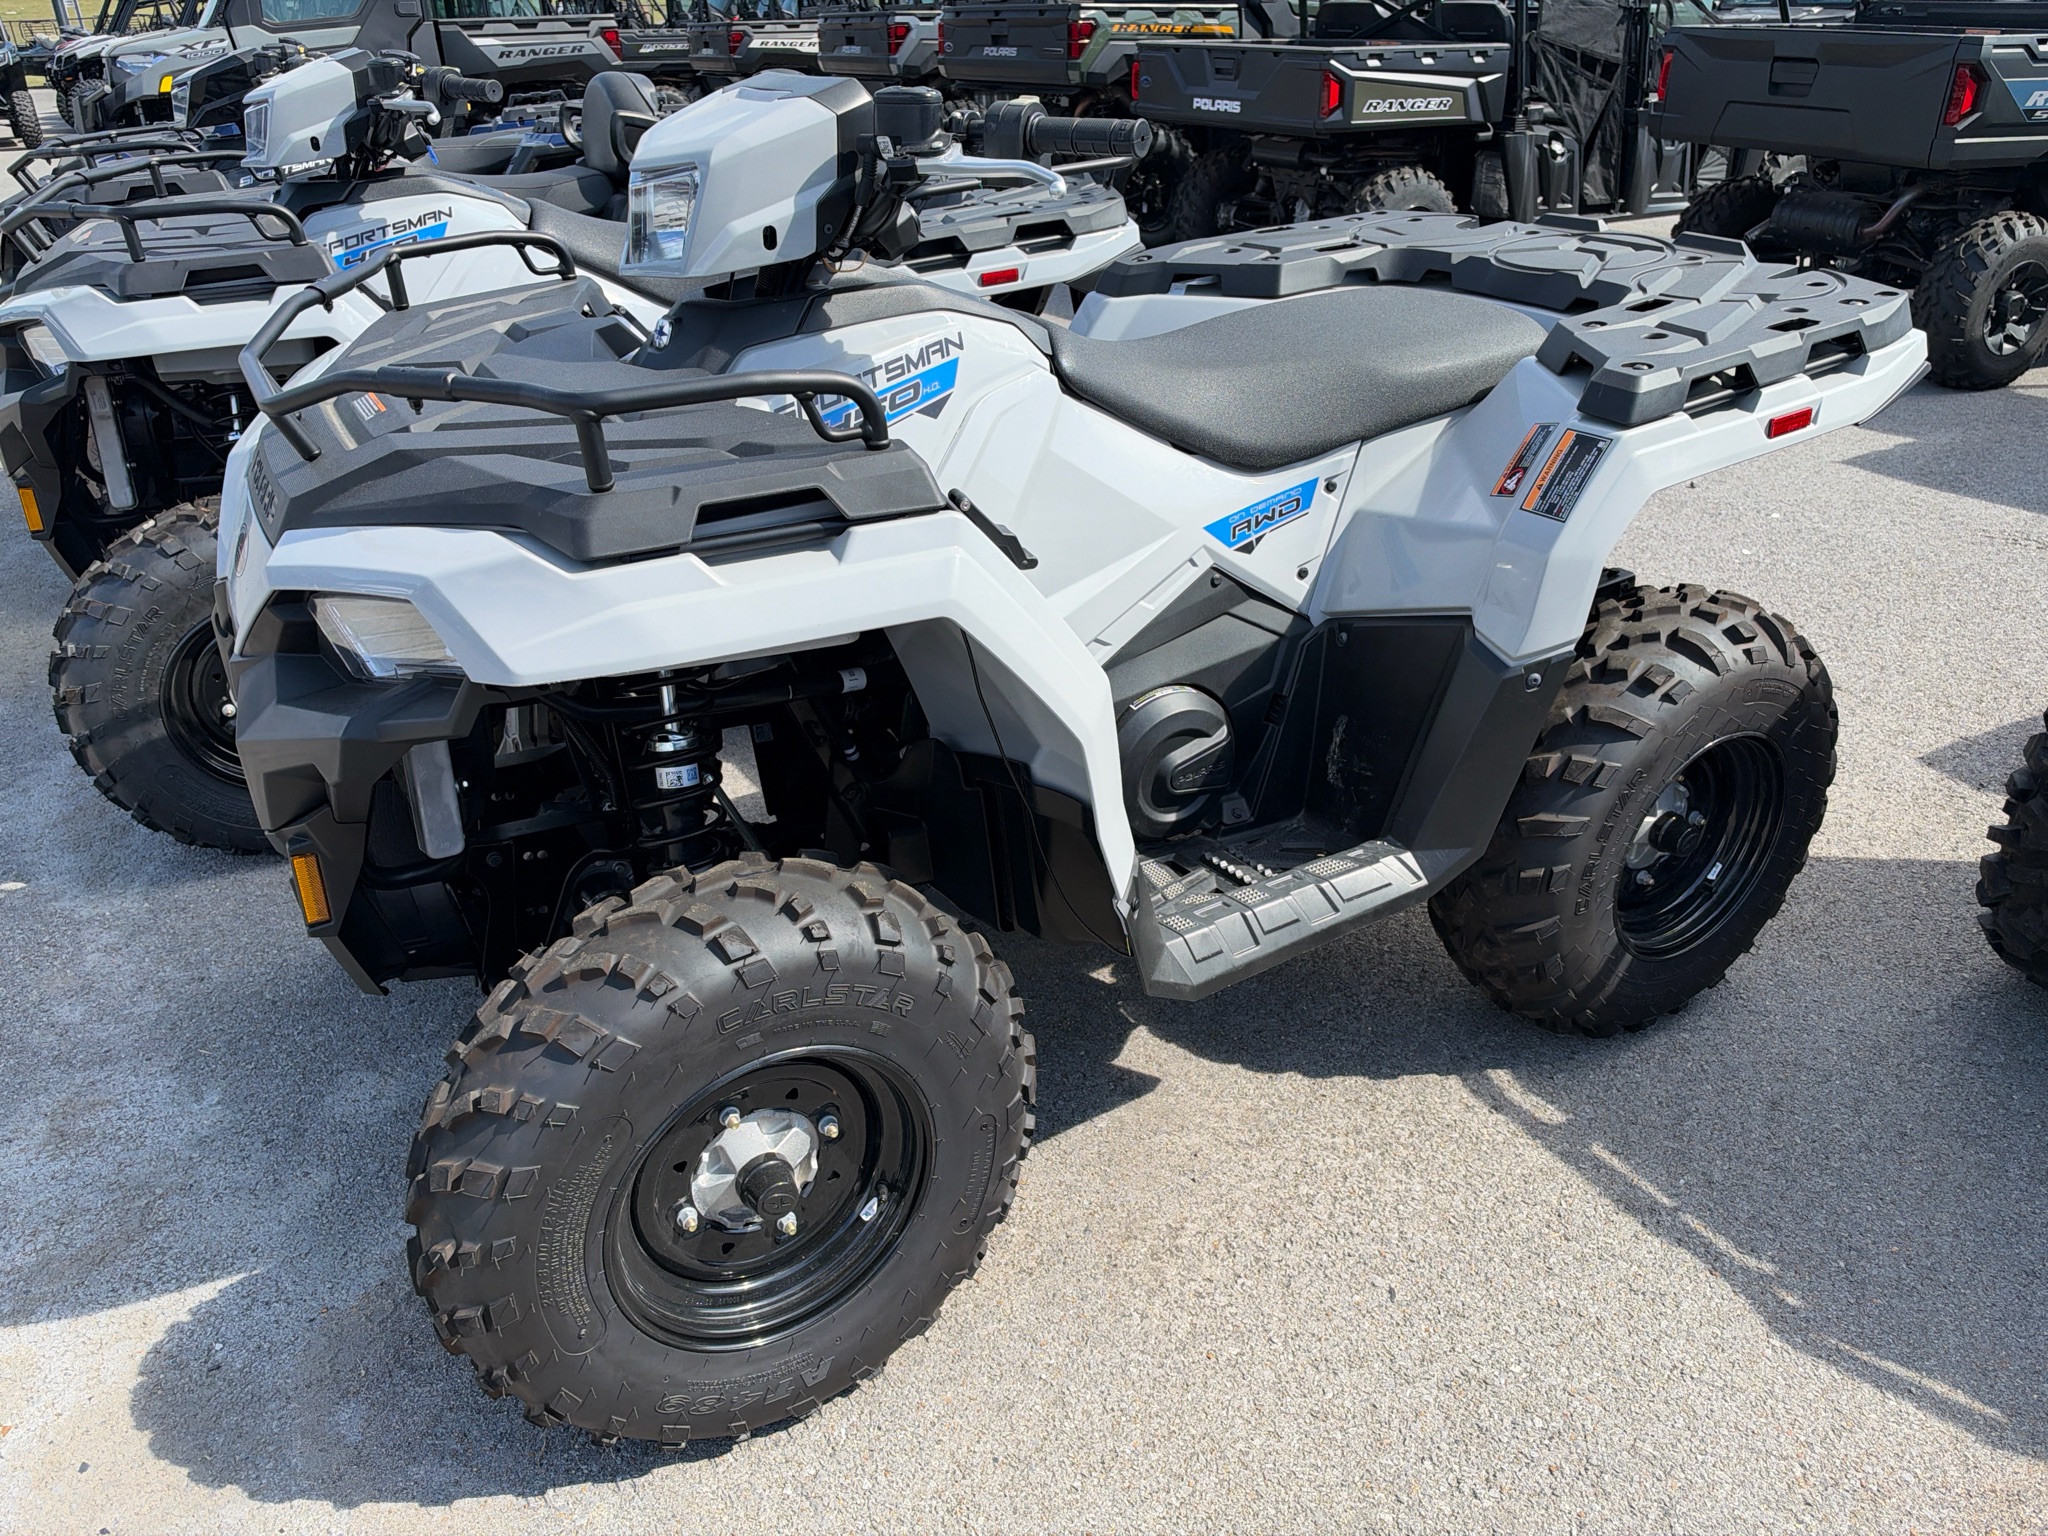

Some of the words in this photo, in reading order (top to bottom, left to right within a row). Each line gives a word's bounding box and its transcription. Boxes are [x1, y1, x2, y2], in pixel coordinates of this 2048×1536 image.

[176, 38, 226, 53] XP
[498, 45, 585, 59] RANGER
[983, 47, 1018, 57] POLARIS
[1192, 97, 1241, 113] POLARIS
[1362, 97, 1453, 113] RANGER
[323, 206, 453, 255] PORTSMAN
[1540, 449, 1563, 481] WARNING
[1231, 496, 1302, 541] AWD
[1575, 768, 1647, 917] CARLSTAR
[716, 983, 916, 1035] CARLSTAR
